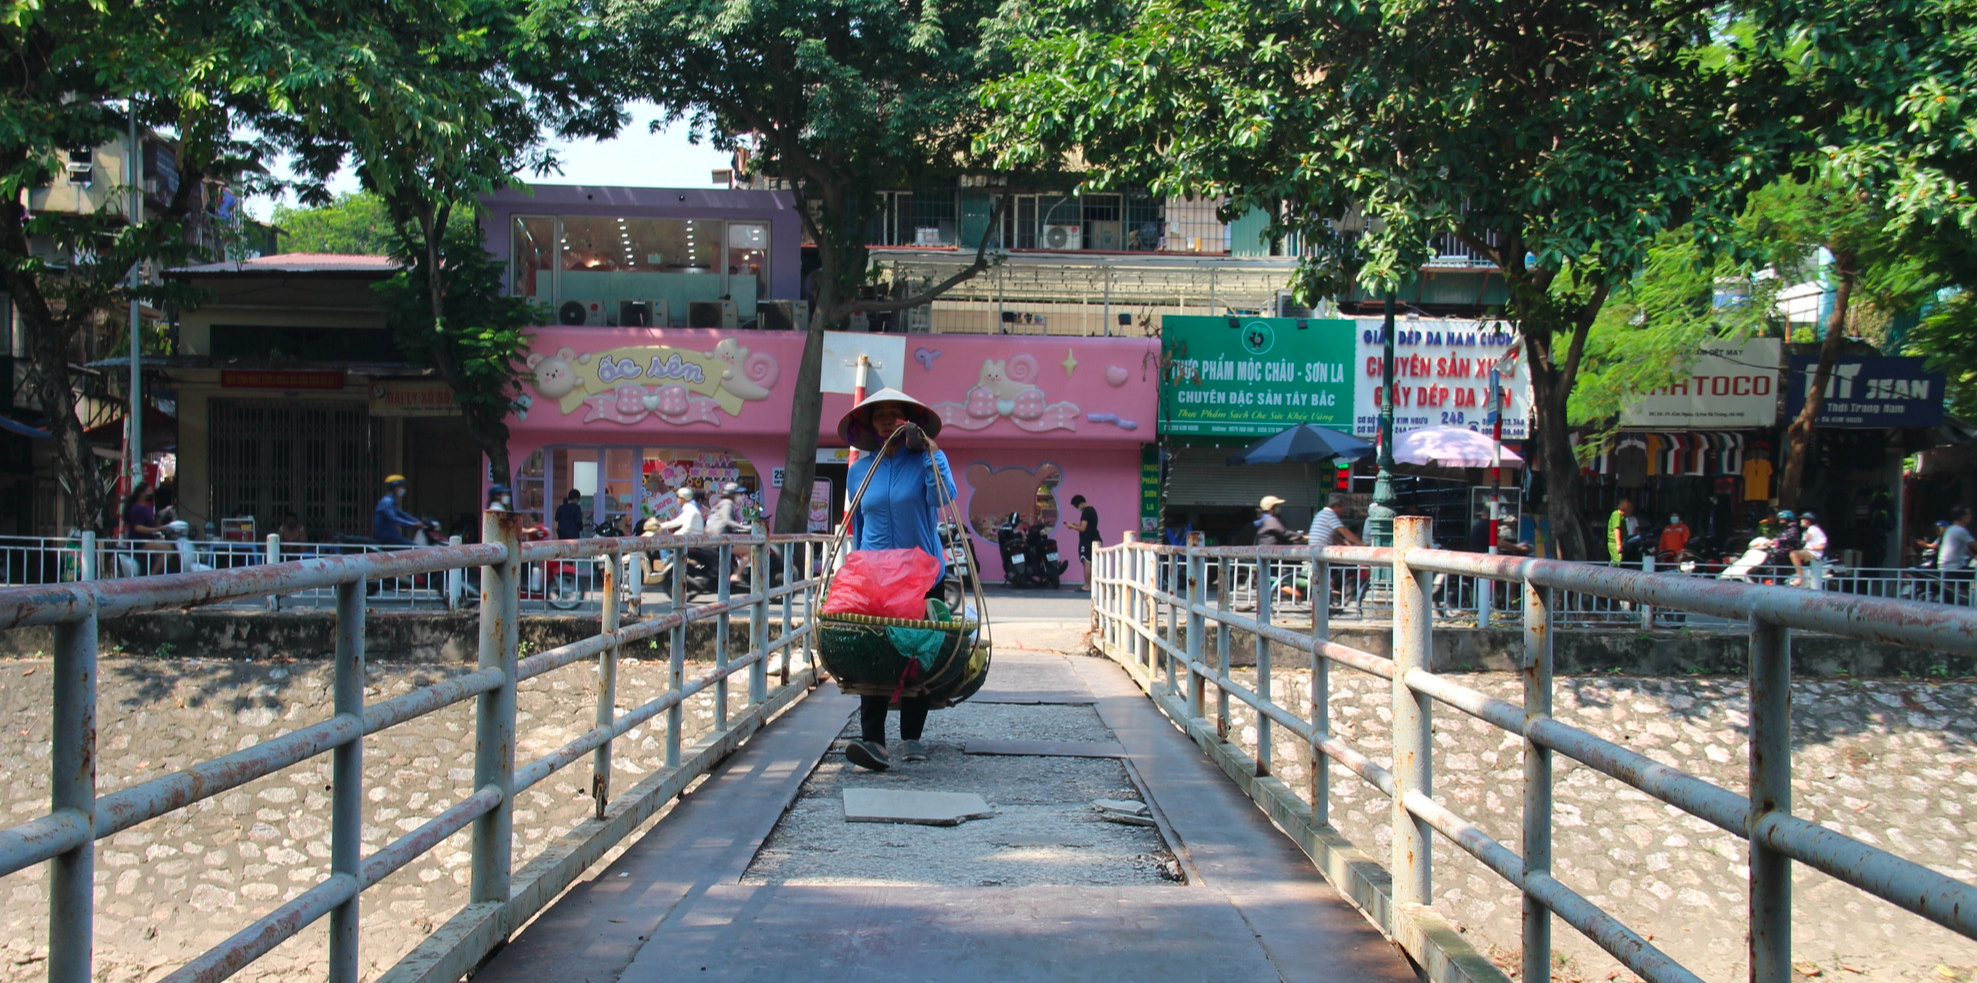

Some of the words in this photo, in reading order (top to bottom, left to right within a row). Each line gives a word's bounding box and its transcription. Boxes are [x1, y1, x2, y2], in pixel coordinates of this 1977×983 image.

[1425, 330, 1442, 346] DA
[1446, 331, 1476, 346] NAM
[1725, 349, 1744, 357] MAY
[647, 353, 705, 385] sên
[1237, 358, 1262, 386] MỘC
[1265, 358, 1295, 382] CHÂU
[1305, 361, 1328, 383] SƠN
[1331, 363, 1344, 383] LA
[1437, 350, 1470, 378] SẢN
[1178, 389, 1226, 404] CHUYÊN
[1229, 390, 1253, 407] ĐẶC
[1257, 389, 1282, 406] SẢN
[1286, 391, 1307, 406] TÂY
[1311, 390, 1335, 407] BẮC
[1417, 382, 1449, 407] DÉP
[1454, 386, 1476, 407] DA
[1865, 378, 1930, 400] JEAN
[1441, 411, 1464, 425] 248
[1850, 403, 1881, 415] Trang
[1883, 404, 1906, 414] Nam
